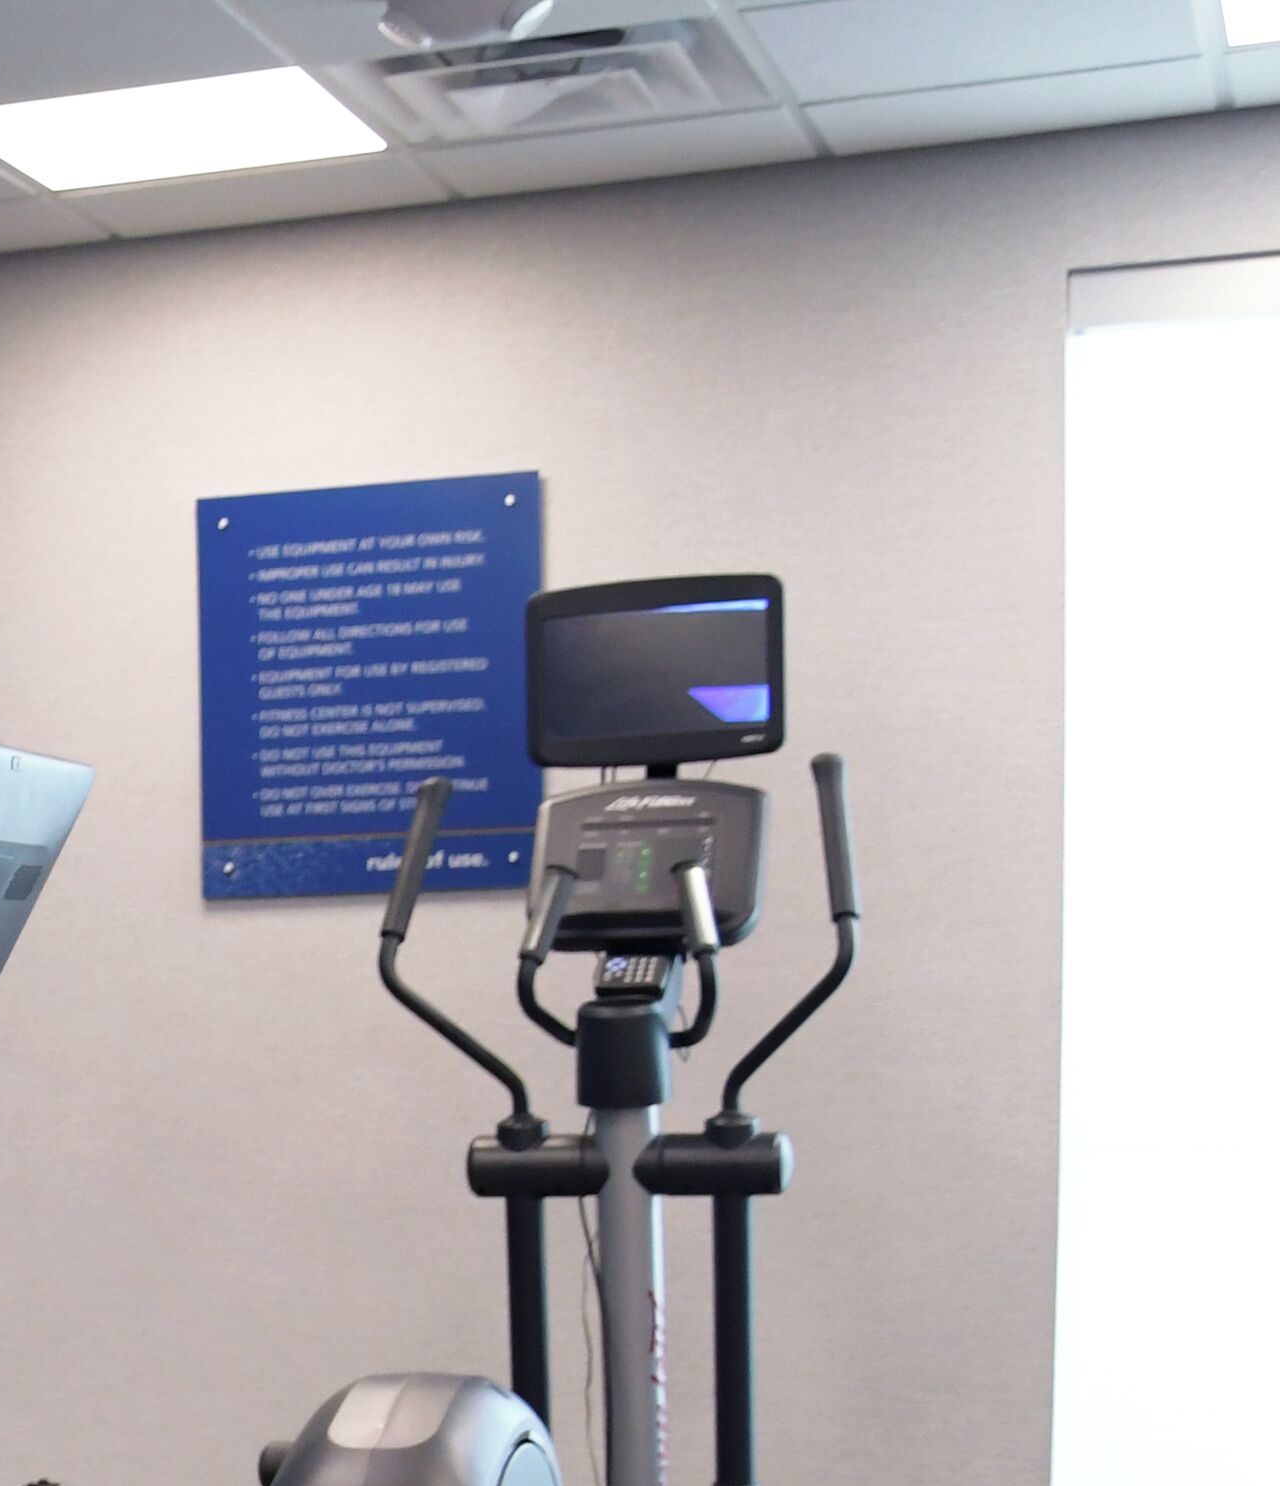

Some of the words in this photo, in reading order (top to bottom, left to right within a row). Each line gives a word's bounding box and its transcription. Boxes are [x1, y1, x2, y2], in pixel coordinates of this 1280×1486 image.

[256, 544, 279, 559] USE
[282, 538, 357, 558] EQUIPMENT
[358, 537, 375, 550] AT
[379, 534, 416, 550] YOUR
[417, 531, 452, 548] OWN
[256, 565, 319, 582] IMPROPER
[320, 563, 344, 579] USE
[346, 562, 374, 576] CAN
[376, 557, 420, 574] RESULT
[422, 557, 437, 570] IN
[257, 592, 278, 605] NO
[279, 589, 307, 604] ONE
[309, 585, 354, 602] UNDER
[355, 584, 383, 598] AGE
[403, 581, 433, 595] MAY
[436, 579, 461, 593] USE
[258, 607, 282, 621] THE
[257, 629, 311, 645] FOLLOW
[312, 628, 336, 641] ALL
[338, 622, 413, 639] DIRECTIONS
[414, 620, 441, 635] FOR
[443, 618, 468, 633] USE
[258, 647, 275, 661] OF
[259, 666, 333, 685] EQUIPMENT
[335, 665, 361, 678] FOR
[363, 663, 388, 677] USE
[390, 662, 409, 676] BY
[410, 657, 489, 674] REGISTERED
[258, 684, 305, 700] GUESTS
[259, 708, 307, 722] FITNESS
[309, 704, 359, 719] CENTER
[360, 704, 372, 716] IS
[374, 702, 404, 716] NOT
[259, 725, 280, 739] DO
[281, 724, 309, 738] NOT
[311, 720, 368, 737] EXERCISE
[259, 749, 280, 762] DO
[281, 747, 309, 761] NOT
[311, 745, 335, 760] USE
[367, 739, 443, 757] EQUIPMENT
[260, 763, 320, 778] WITHOUT
[260, 788, 280, 801] DO
[281, 786, 309, 801] NOT
[309, 784, 343, 799] OVER
[260, 802, 283, 817] USE
[286, 801, 303, 815] AT
[305, 801, 338, 815] FIRST
[340, 800, 376, 814] SIGNS
[378, 798, 395, 812] OF
[448, 853, 488, 868] use.
